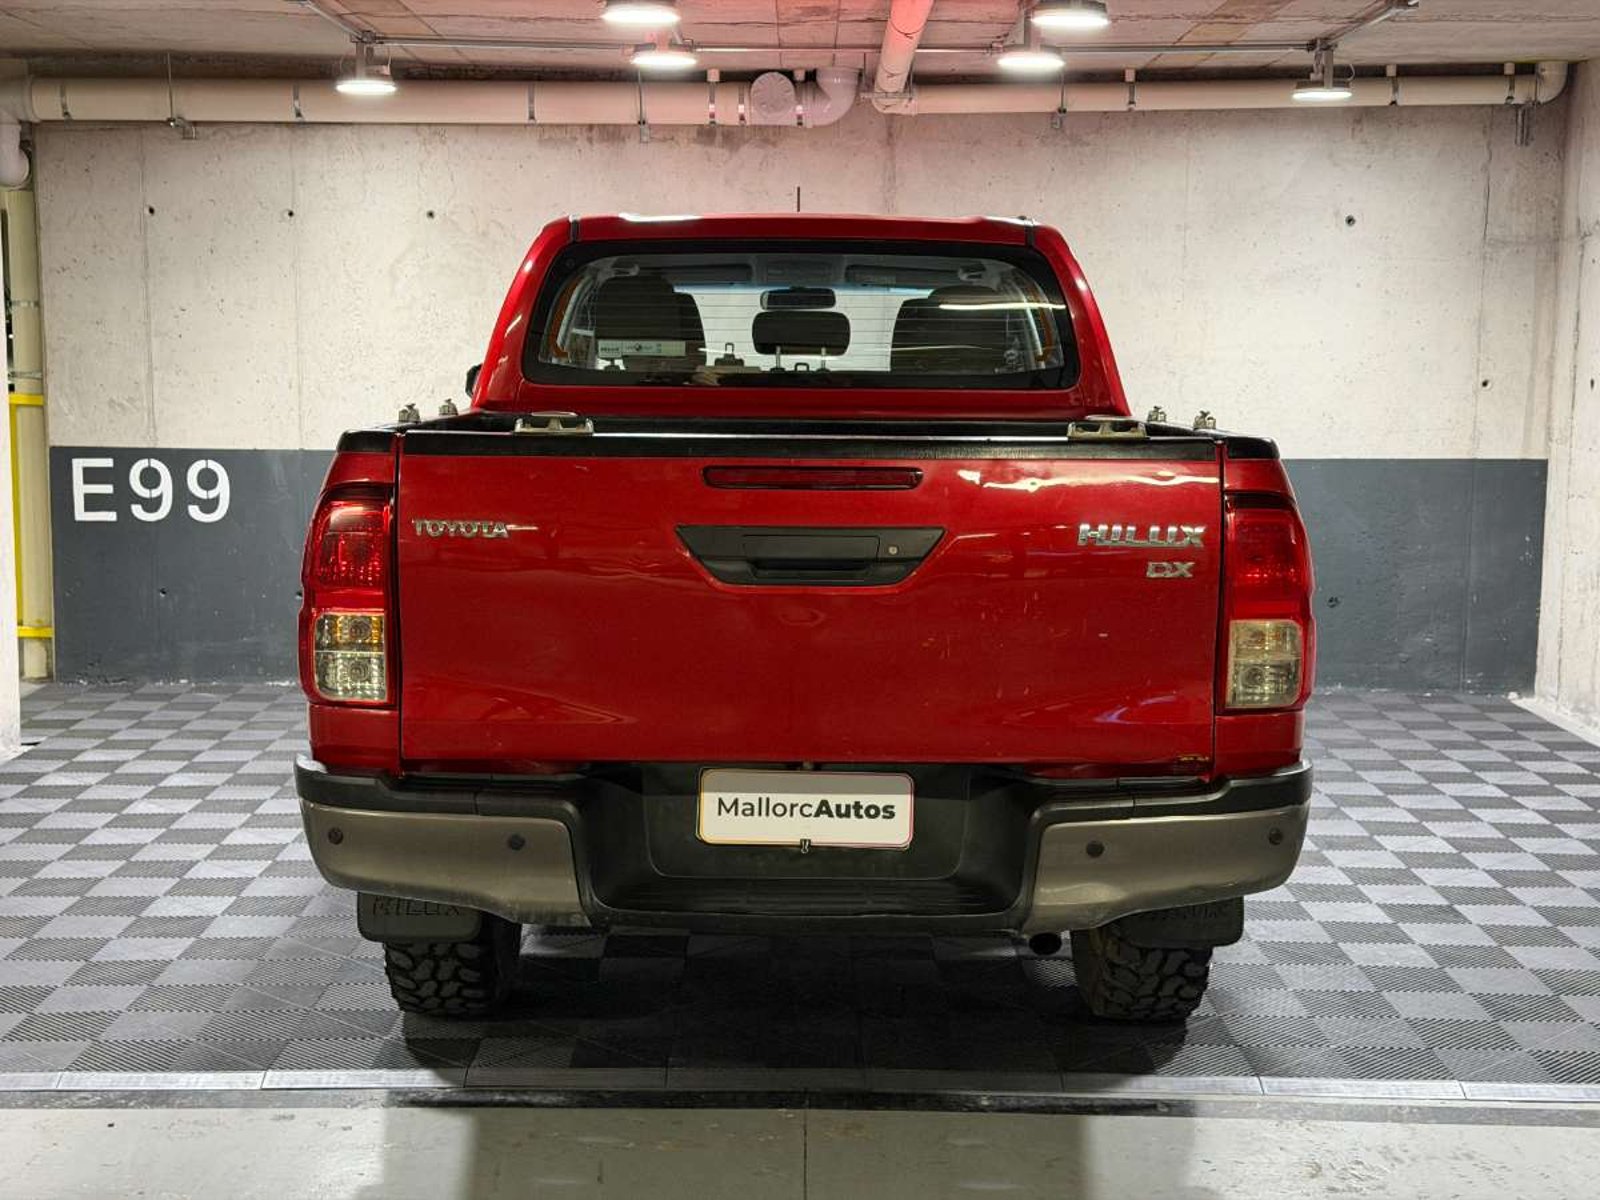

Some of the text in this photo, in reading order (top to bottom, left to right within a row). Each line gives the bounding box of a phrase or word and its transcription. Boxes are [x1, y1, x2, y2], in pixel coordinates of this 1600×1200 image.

[72, 457, 231, 523] E99
[413, 518, 509, 538] TOYOTA
[1077, 523, 1206, 547] HILUX
[1146, 561, 1195, 578] DX
[717, 797, 896, 820] MallorcAutos
